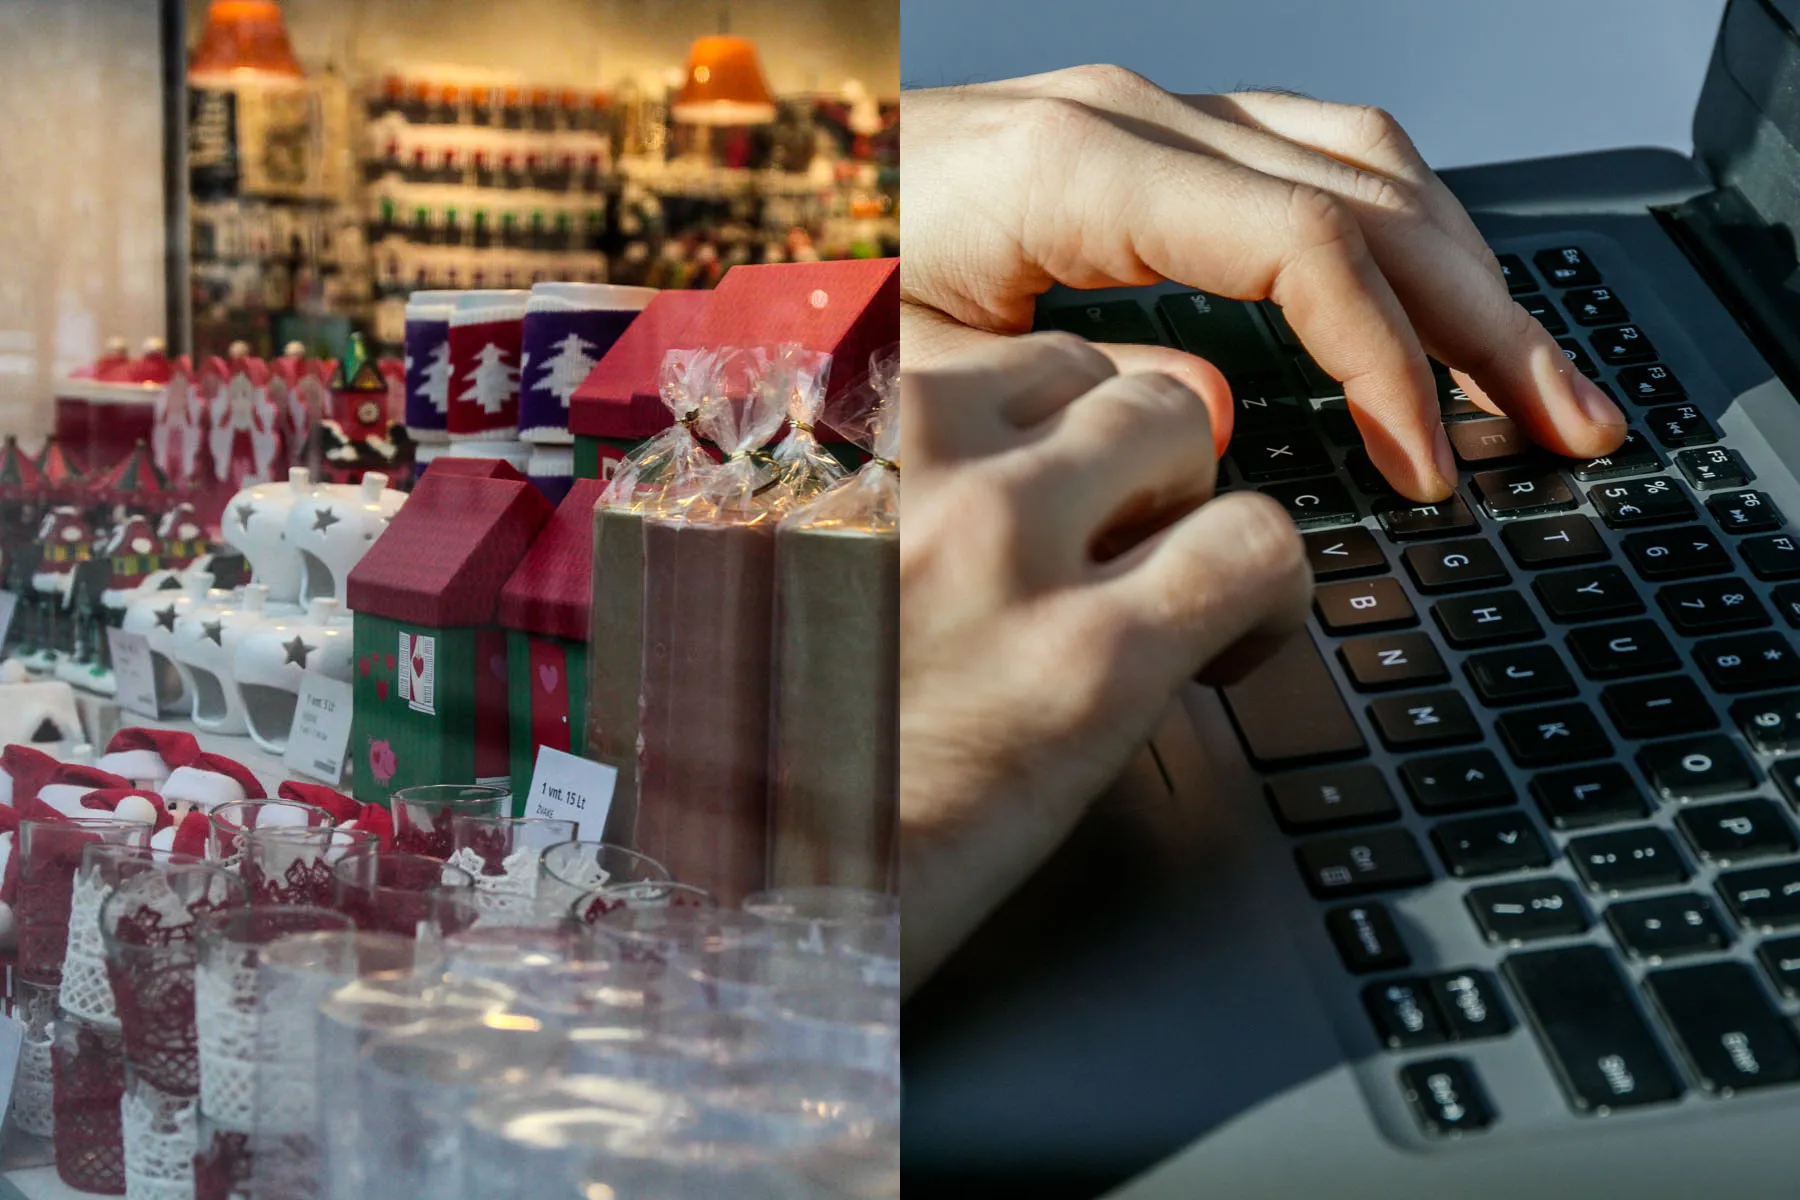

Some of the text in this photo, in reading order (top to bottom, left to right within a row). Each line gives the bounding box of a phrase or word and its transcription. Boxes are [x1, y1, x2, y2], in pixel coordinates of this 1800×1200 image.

[1592, 289, 1610, 300] F1
[1619, 327, 1638, 340] F2
[1648, 367, 1666, 379] F3
[1242, 397, 1268, 409] Z
[1677, 407, 1697, 419] F4
[1480, 434, 1507, 446] E
[1266, 445, 1293, 458] X
[1707, 450, 1728, 464] F5
[1509, 481, 1535, 494] R
[1605, 488, 1628, 497] 5
[1295, 495, 1319, 506] C
[1739, 492, 1763, 507] F6
[1410, 506, 1439, 516] F
[1544, 530, 1570, 542] T
[1322, 543, 1349, 555] V
[1772, 538, 1794, 551] F7
[1646, 546, 1669, 557] 6
[1443, 554, 1469, 567] G
[1577, 581, 1604, 594] Y
[1350, 596, 1377, 609] B
[1681, 598, 1705, 608] 7
[1472, 607, 1502, 623] H
[1609, 637, 1637, 652] U
[1378, 649, 1407, 665] N
[1717, 655, 1741, 667] 8
[1506, 666, 1534, 678] J
[1408, 706, 1440, 725] M
[1755, 713, 1781, 726] 9
[1539, 722, 1570, 739] K
[542, 782, 547, 795] 1
[566, 791, 576, 806] 15
[576, 793, 586, 810] Lt
[1574, 783, 1601, 800] L
[1720, 817, 1753, 834] P
